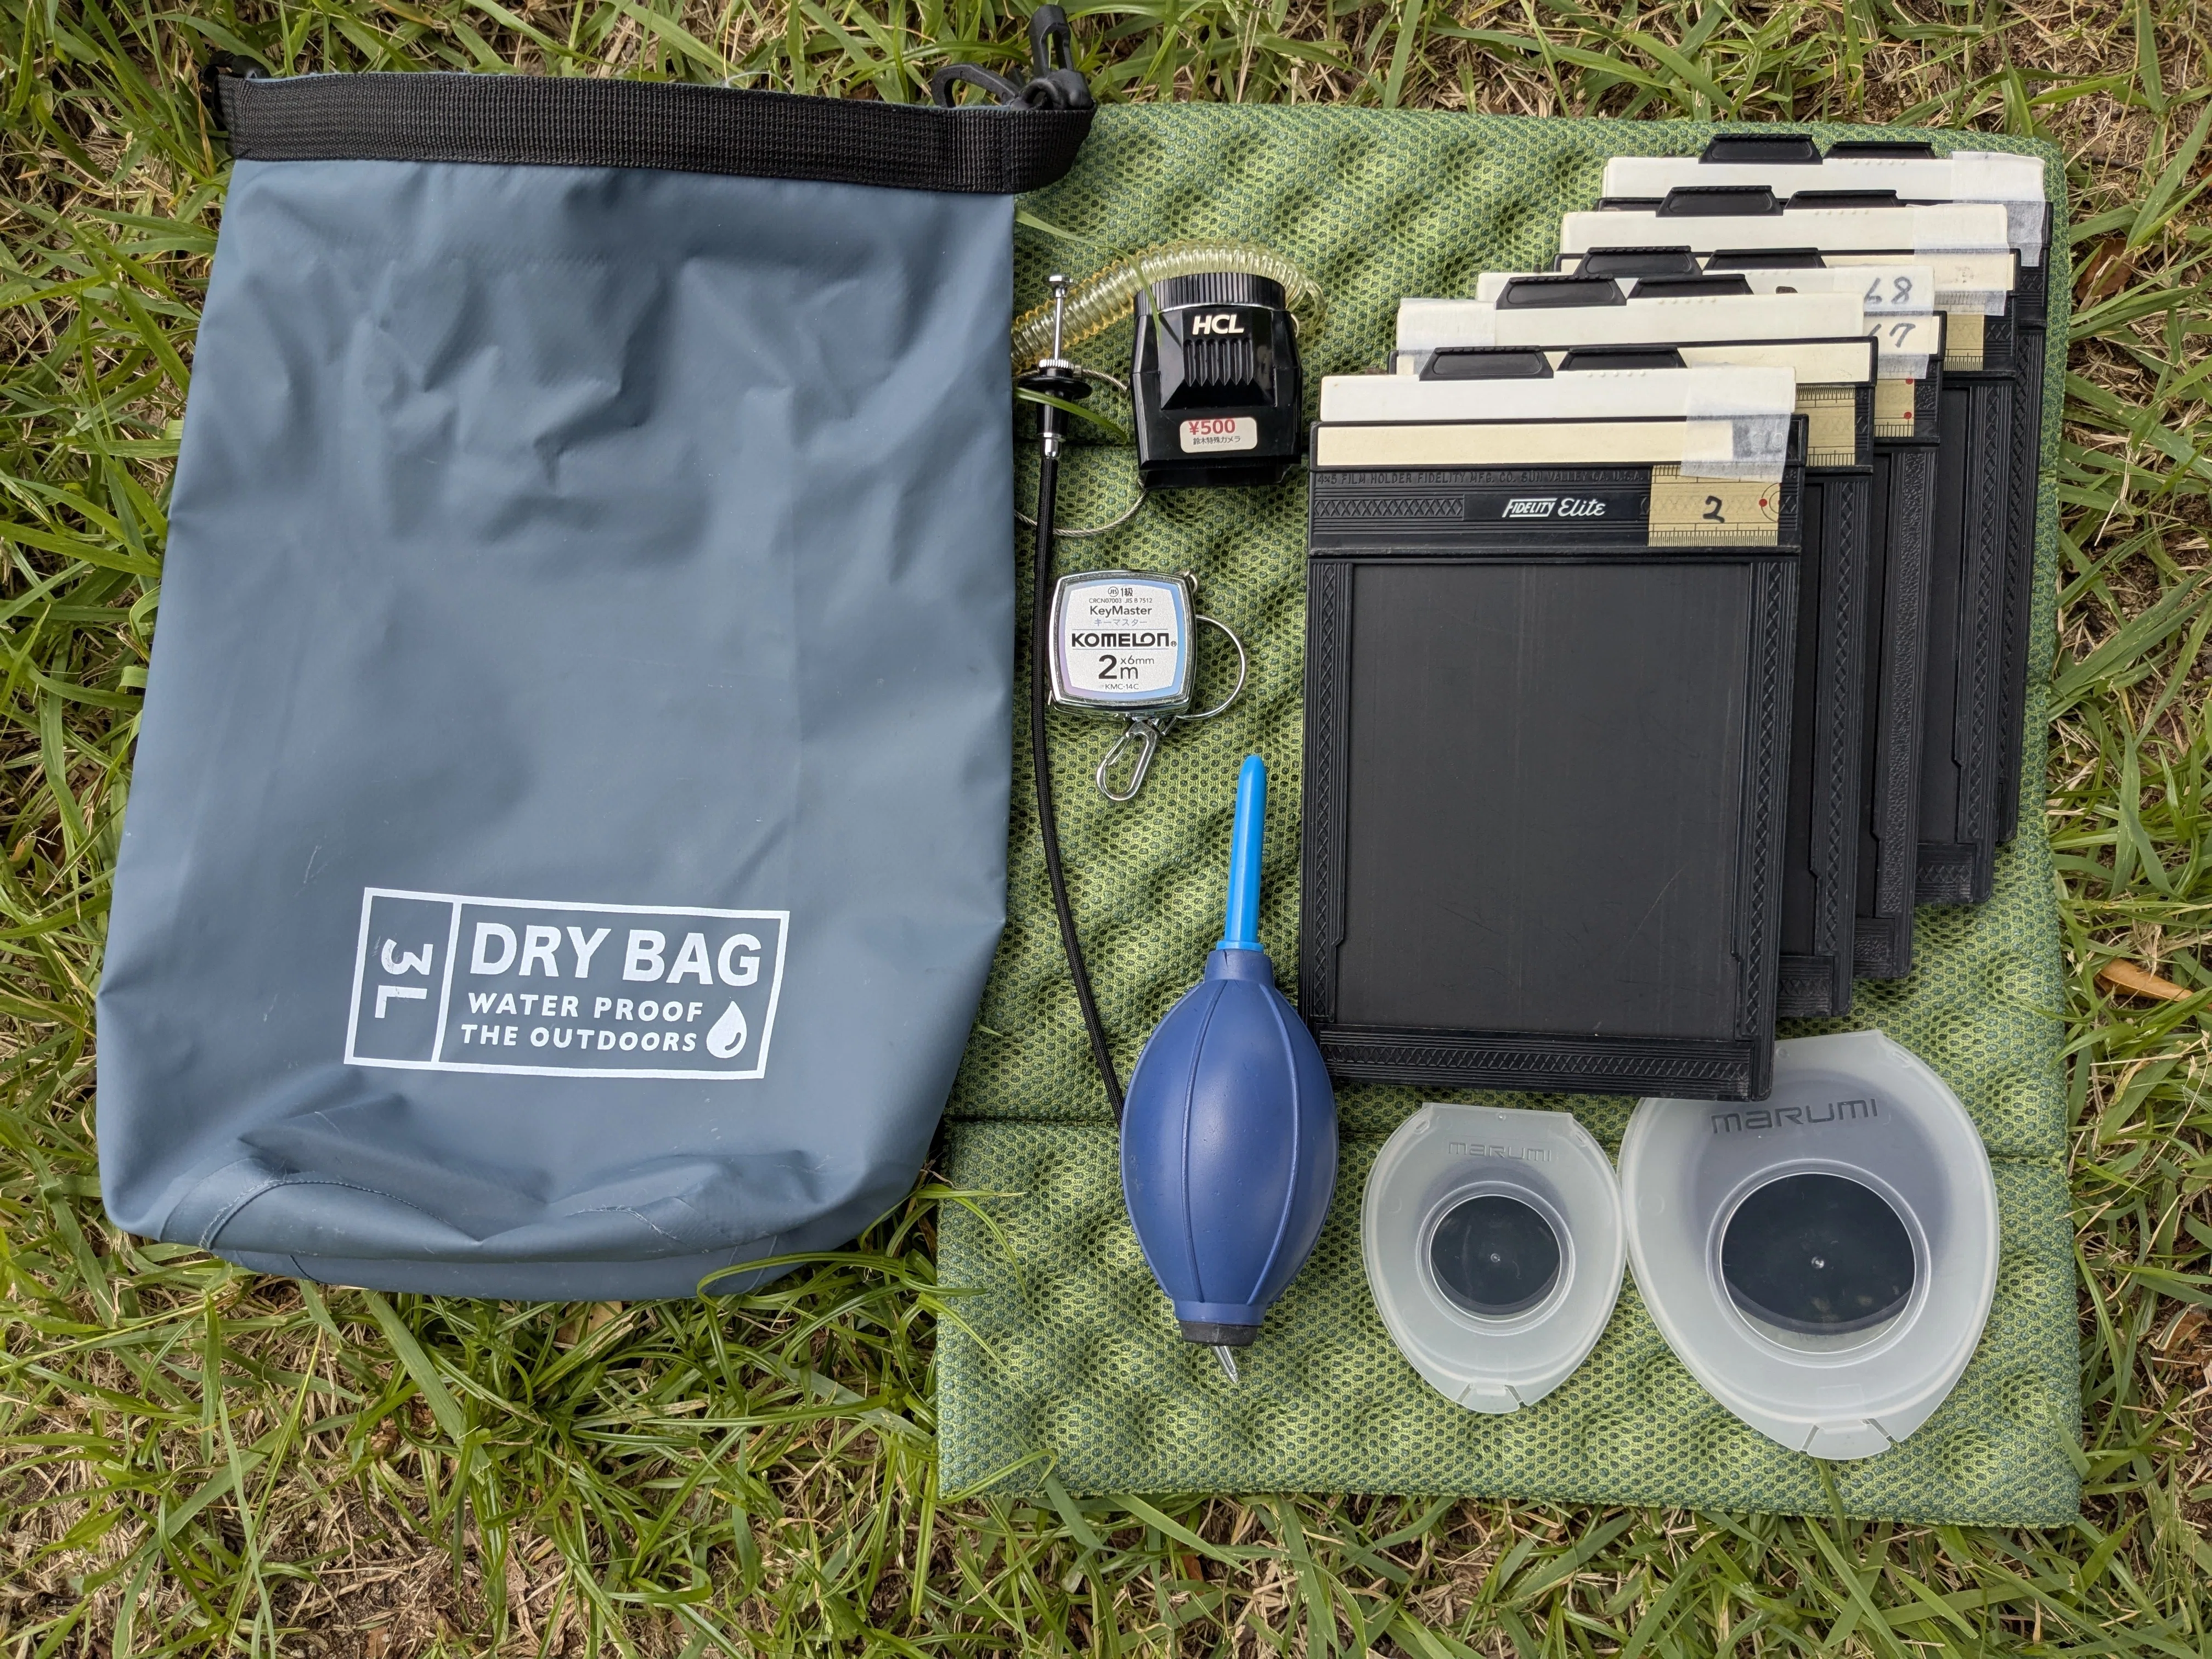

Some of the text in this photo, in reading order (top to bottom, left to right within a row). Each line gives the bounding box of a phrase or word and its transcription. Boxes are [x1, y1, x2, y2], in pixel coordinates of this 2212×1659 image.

[1192, 314, 1244, 335] HCL
[1188, 419, 1235, 435] ¥500
[1193, 436, 1241, 445] 鈴木特殊カメラ
[1341, 473, 1365, 484] FILM
[1370, 472, 1412, 484] HOLDER
[1418, 472, 1465, 483] FIDELITY
[1470, 472, 1494, 483] MFG.
[1499, 472, 1517, 483] CO.
[1521, 471, 1542, 483] SUN
[1547, 471, 1587, 482] VALLEY
[1502, 498, 1606, 517] FIDELITY Elite
[1703, 495, 1725, 523] 2
[1121, 588, 1133, 597] 1級
[1090, 606, 1152, 618] KeyMaster
[1094, 618, 1148, 627] キーマスター
[470, 922, 762, 986] DRY BAG
[468, 992, 703, 1022] WATER PROOF
[461, 1024, 697, 1052] THE OUTDOORS
